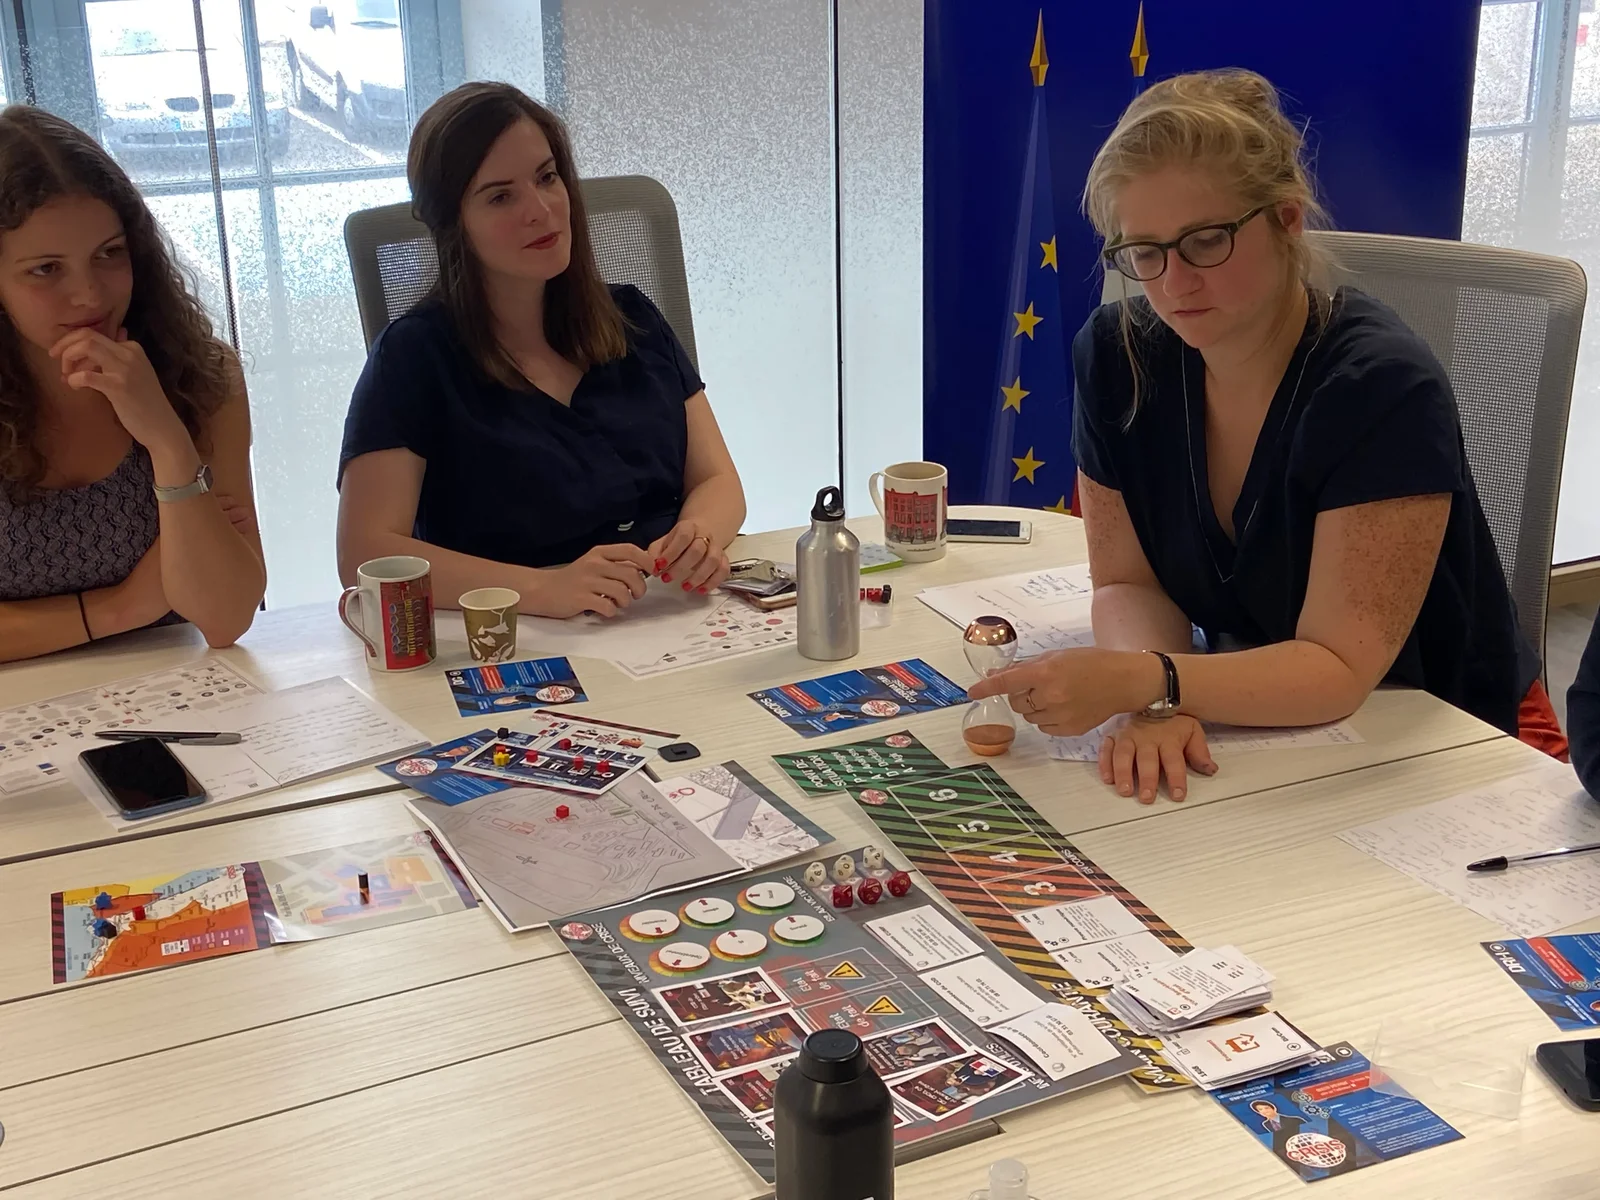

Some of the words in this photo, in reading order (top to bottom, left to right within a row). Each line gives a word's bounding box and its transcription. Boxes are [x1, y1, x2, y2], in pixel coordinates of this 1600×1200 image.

[453, 677, 465, 686] DG
[791, 758, 810, 769] DE
[807, 754, 847, 786] SITUATION
[800, 768, 828, 788] POINT
[928, 788, 959, 802] 6
[958, 819, 991, 834] 5
[989, 850, 1020, 864] 4
[1059, 848, 1086, 866] COURS
[1079, 866, 1095, 874] EN
[779, 875, 821, 905] VICTIMAIRE
[1023, 881, 1057, 897] 3
[811, 904, 836, 921] BILAN
[588, 922, 617, 943] CRISE
[606, 942, 625, 953] DE
[615, 953, 652, 983] NIVEAUX
[1495, 952, 1526, 973] DRH
[803, 968, 823, 981] fait
[815, 980, 833, 990] de
[616, 987, 657, 1018] SUIVI
[839, 1004, 861, 1017] fait
[642, 1017, 672, 1036] DE
[853, 1016, 872, 1027] de
[1015, 1031, 1051, 1058] Coordonnées
[656, 1034, 724, 1096] TABLEAU
[1286, 1139, 1347, 1162] CRISIS
